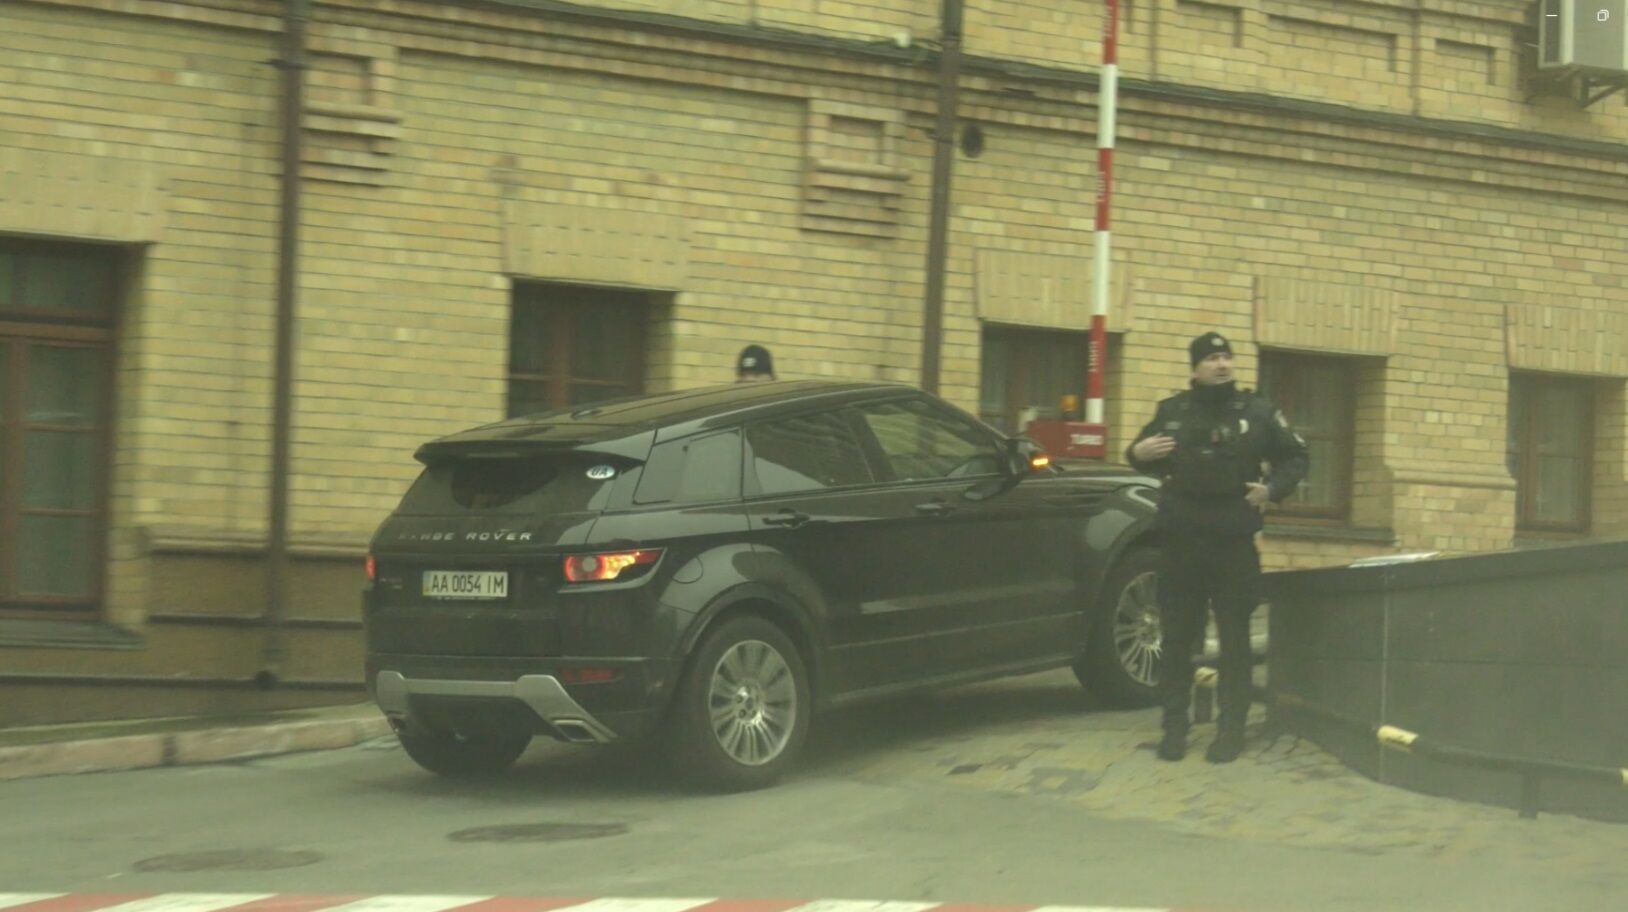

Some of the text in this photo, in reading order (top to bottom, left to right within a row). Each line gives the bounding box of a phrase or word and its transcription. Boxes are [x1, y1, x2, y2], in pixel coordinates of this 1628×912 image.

[466, 531, 533, 541] ROVER
[431, 575, 505, 594] AA 0054 IM
